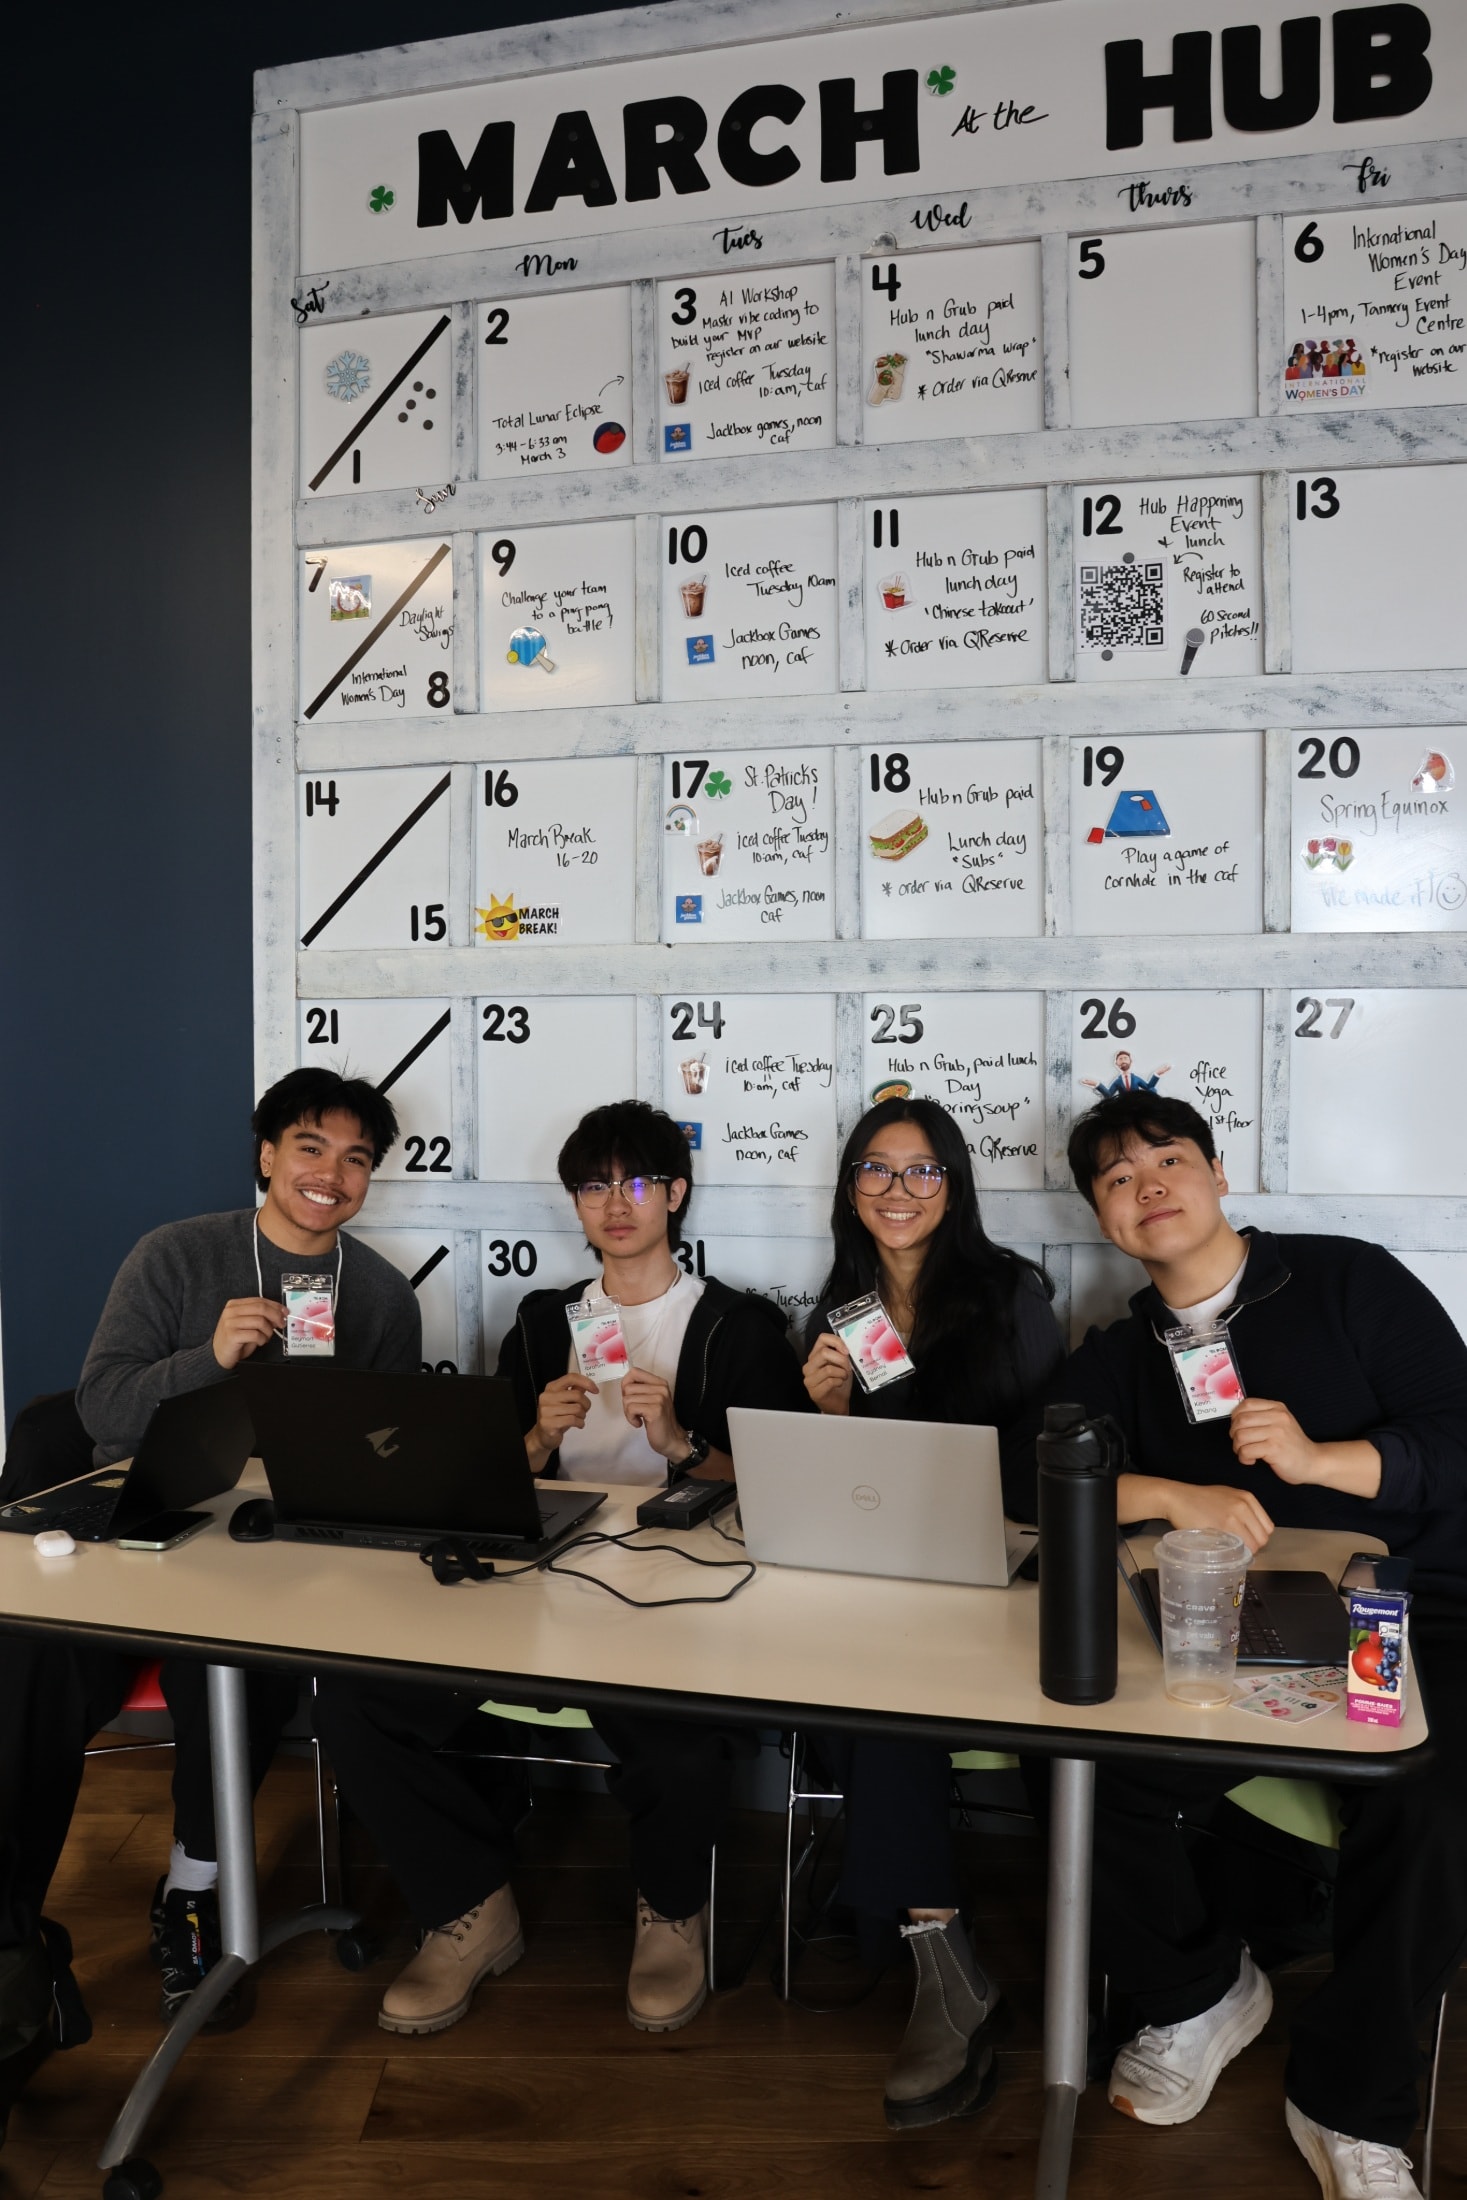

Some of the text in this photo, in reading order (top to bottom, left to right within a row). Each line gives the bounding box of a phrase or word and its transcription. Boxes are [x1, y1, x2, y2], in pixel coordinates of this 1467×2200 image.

[416, 3, 1433, 229] MARCH At the HUB
[1294, 221, 1324, 264] 6
[1353, 220, 1436, 249] International
[291, 281, 330, 324] Sat
[515, 254, 578, 276] Mon
[712, 225, 764, 254] Tues
[910, 201, 972, 232] Wed
[1078, 238, 1105, 280] 5
[1368, 242, 1467, 272] Women's Day
[871, 263, 902, 302] 4
[1394, 270, 1442, 291] Event
[671, 287, 697, 326] 3
[741, 286, 799, 306] Workshop
[1415, 293, 1451, 313] Event
[763, 300, 820, 327] coding to
[889, 293, 1015, 327] Hub Grub paid
[485, 308, 510, 345] 2
[737, 326, 762, 341] MVP
[915, 321, 990, 346] lunch day
[1416, 314, 1466, 335] Centre
[787, 331, 829, 349] website
[761, 362, 811, 385] Tuesday
[1285, 378, 1367, 390] INTERNATIONAL
[1340, 385, 1366, 397] DAY
[492, 403, 604, 429] Total Lunar Eclipse
[706, 423, 752, 440] Jackbox
[520, 451, 552, 465] March
[1139, 495, 1244, 520] Hub Happening
[1297, 477, 1340, 521] 13
[873, 509, 899, 548] 11
[1083, 494, 1124, 537] 12
[1170, 515, 1222, 534] Event
[668, 524, 708, 565] 10
[1185, 532, 1225, 549] lunch
[491, 539, 516, 577] 9
[725, 560, 797, 578] Iced coffee
[916, 544, 1035, 569] Hub Grub paid
[305, 557, 328, 593] 7
[945, 574, 1018, 598] lunch day
[1183, 562, 1241, 595] Register to
[1206, 578, 1246, 596] attend
[502, 590, 548, 611] Challenge
[746, 580, 803, 607] Tuesday
[723, 621, 821, 649] Jackbox Games
[939, 636, 958, 650] via
[786, 646, 815, 665] caf
[378, 685, 406, 709] Day
[426, 671, 451, 709] 8
[1083, 745, 1125, 787] 19
[1298, 736, 1361, 779] 20
[672, 760, 710, 799] 17
[870, 753, 911, 793] 18
[306, 780, 340, 817] 14
[485, 769, 518, 808] 16
[919, 783, 1034, 808] Hub Grub paid
[1320, 790, 1450, 837] Spring Equinox
[508, 823, 597, 849] March Break
[948, 832, 1027, 854] Lunch day
[1121, 841, 1230, 873] Play game of
[962, 874, 1026, 893] QReserve
[1168, 864, 1239, 886] in the caf
[411, 903, 447, 942] 15
[518, 907, 560, 920] MARCH
[519, 922, 558, 935] BREAK!
[306, 1007, 339, 1045] 21
[482, 1004, 531, 1044] 23
[670, 1001, 726, 1041] 24
[870, 1004, 924, 1044] 25
[1080, 997, 1136, 1039] 26
[1295, 996, 1355, 1040] 27
[752, 1054, 833, 1088] coffee Tuesday
[888, 1058, 915, 1073] Hub
[973, 1055, 1005, 1074] paid
[1007, 1052, 1038, 1067] lunch
[945, 1079, 981, 1101] Day
[722, 1122, 809, 1143] Jackbox Games
[404, 1135, 452, 1173] 22
[777, 1146, 799, 1162] caf
[980, 1135, 1039, 1163] QReserve
[488, 1240, 538, 1277] 30
[1352, 1603, 1400, 1617] Rougemont
